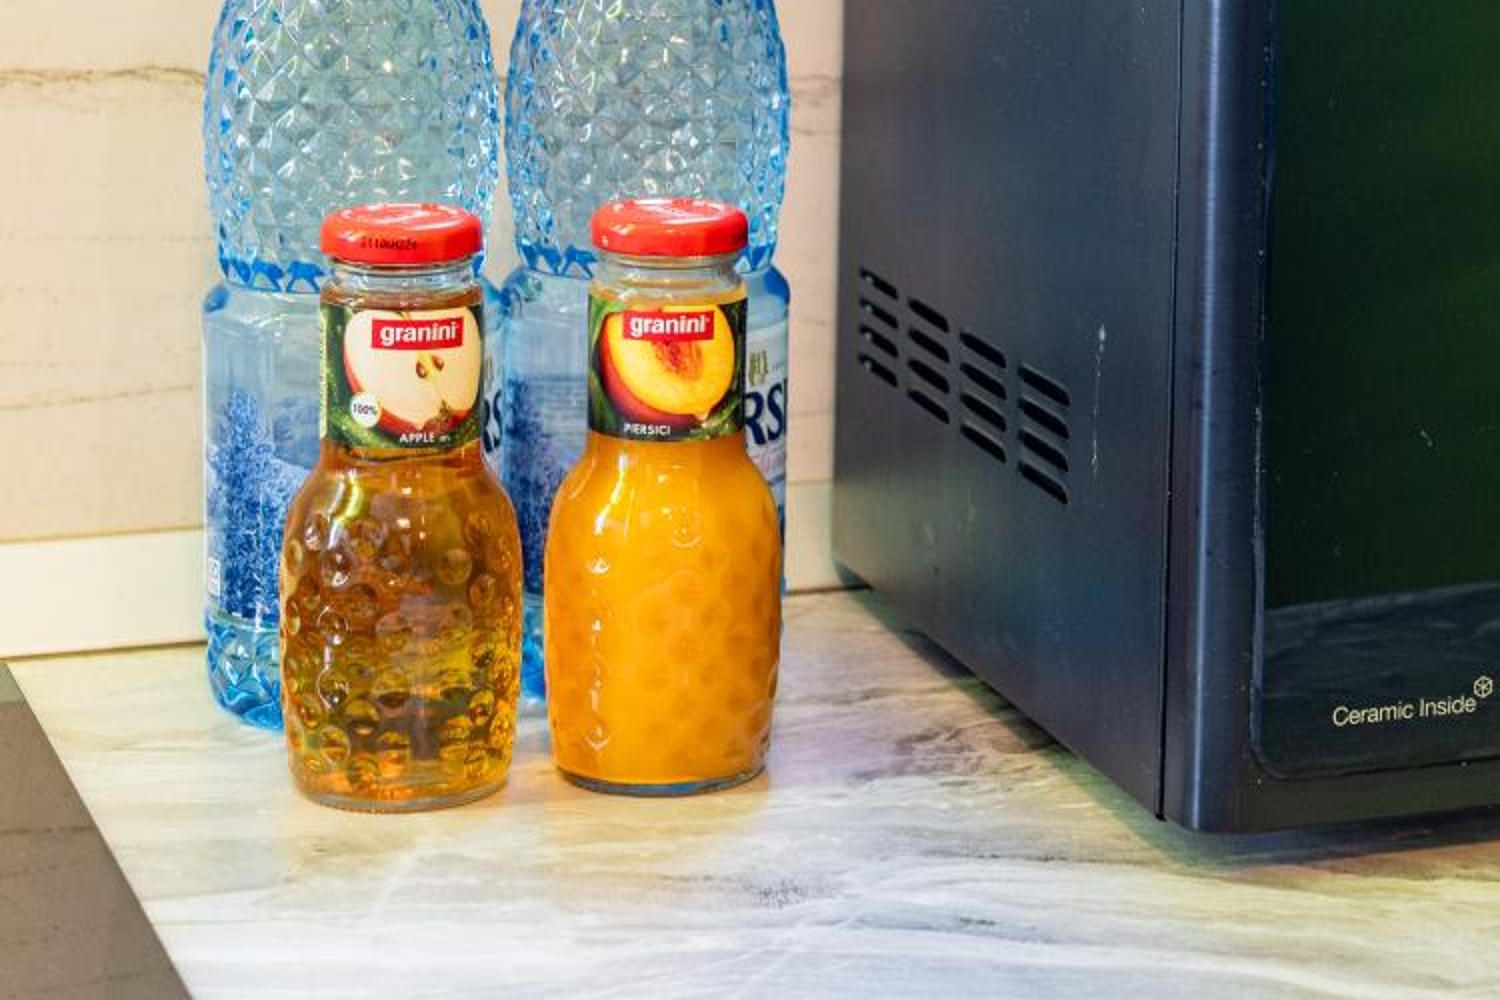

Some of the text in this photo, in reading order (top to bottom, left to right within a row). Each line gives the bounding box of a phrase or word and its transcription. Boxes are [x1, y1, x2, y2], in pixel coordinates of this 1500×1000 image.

[379, 321, 458, 346] granini
[629, 314, 707, 338] granini
[352, 402, 378, 416] 100%
[744, 381, 788, 446] RS
[399, 432, 435, 444] APPLE
[622, 422, 672, 436] PIERSICI
[1332, 694, 1477, 727] Ceramic Inside
